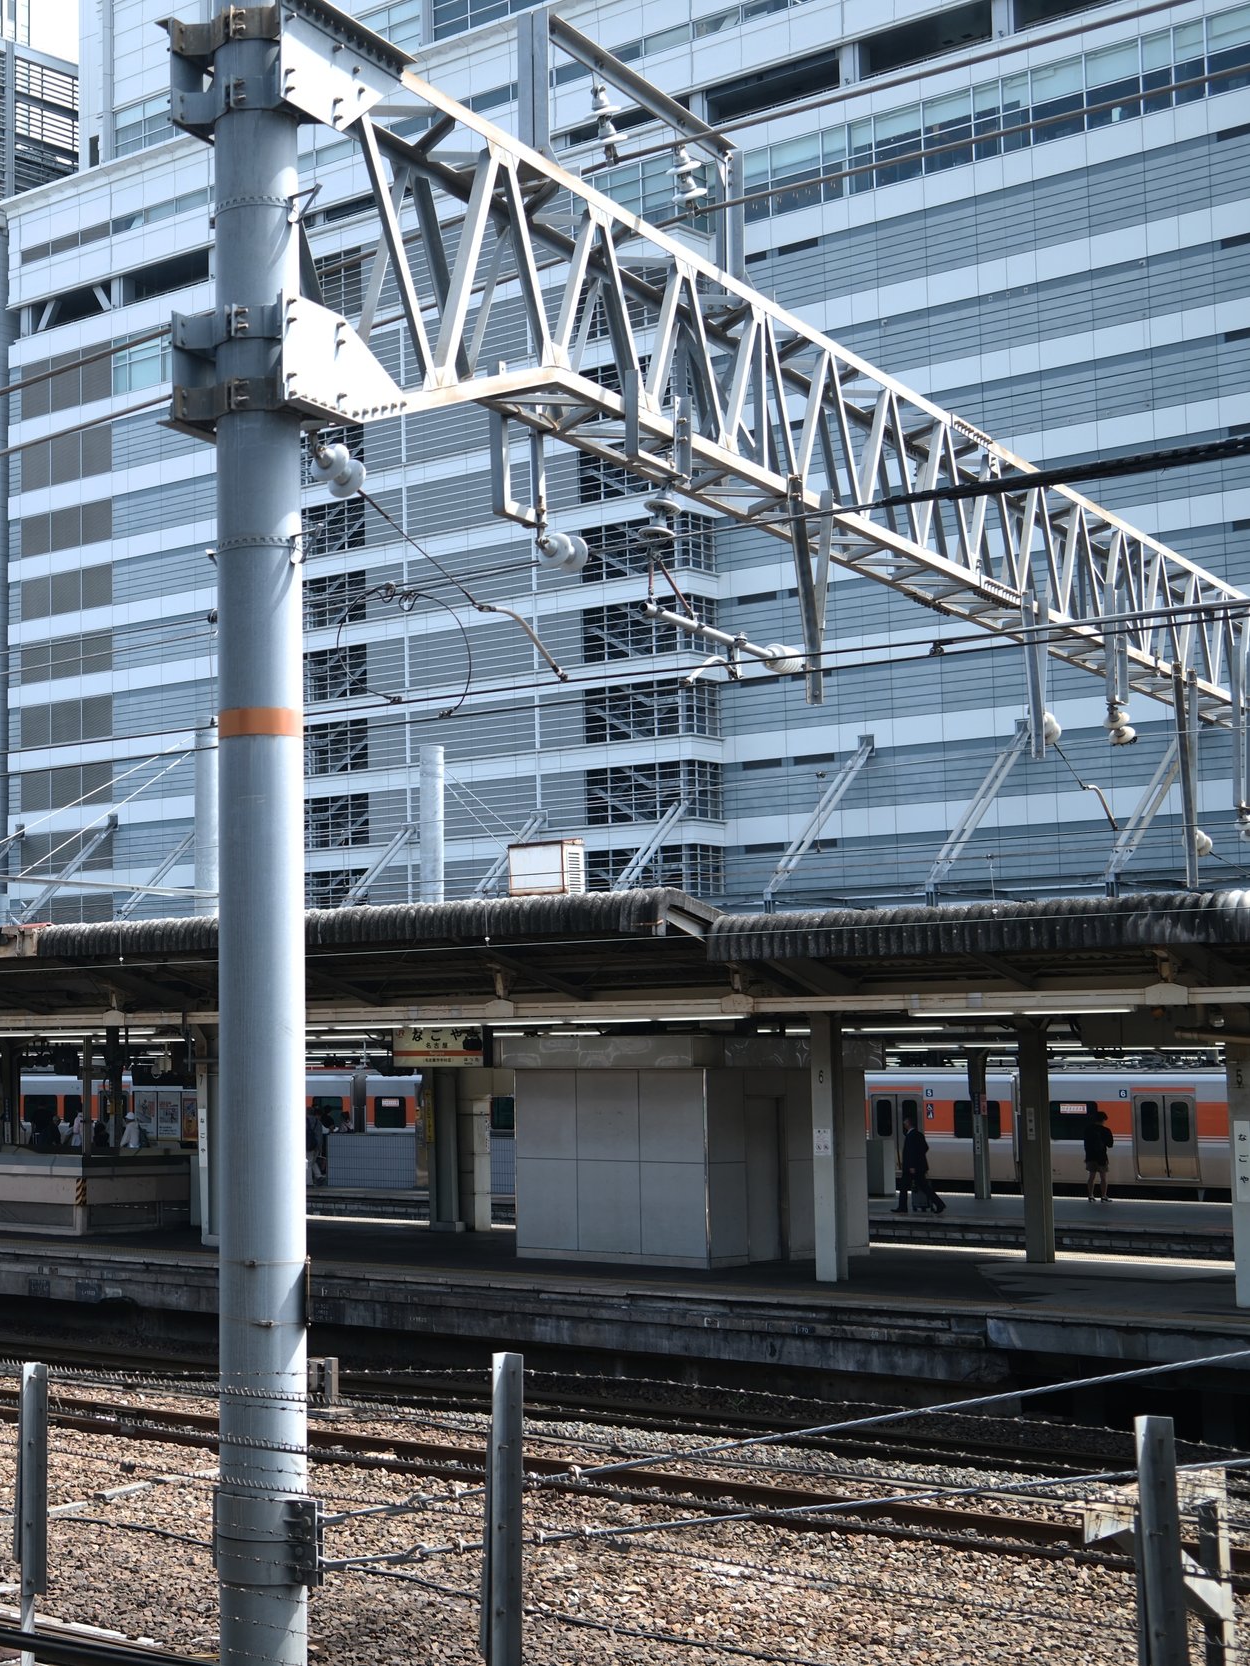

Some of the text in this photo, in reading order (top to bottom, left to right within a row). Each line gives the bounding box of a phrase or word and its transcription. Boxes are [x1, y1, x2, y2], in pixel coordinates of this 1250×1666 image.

[818, 1070, 824, 1084] 6
[1238, 1133, 1249, 1183] なごや
